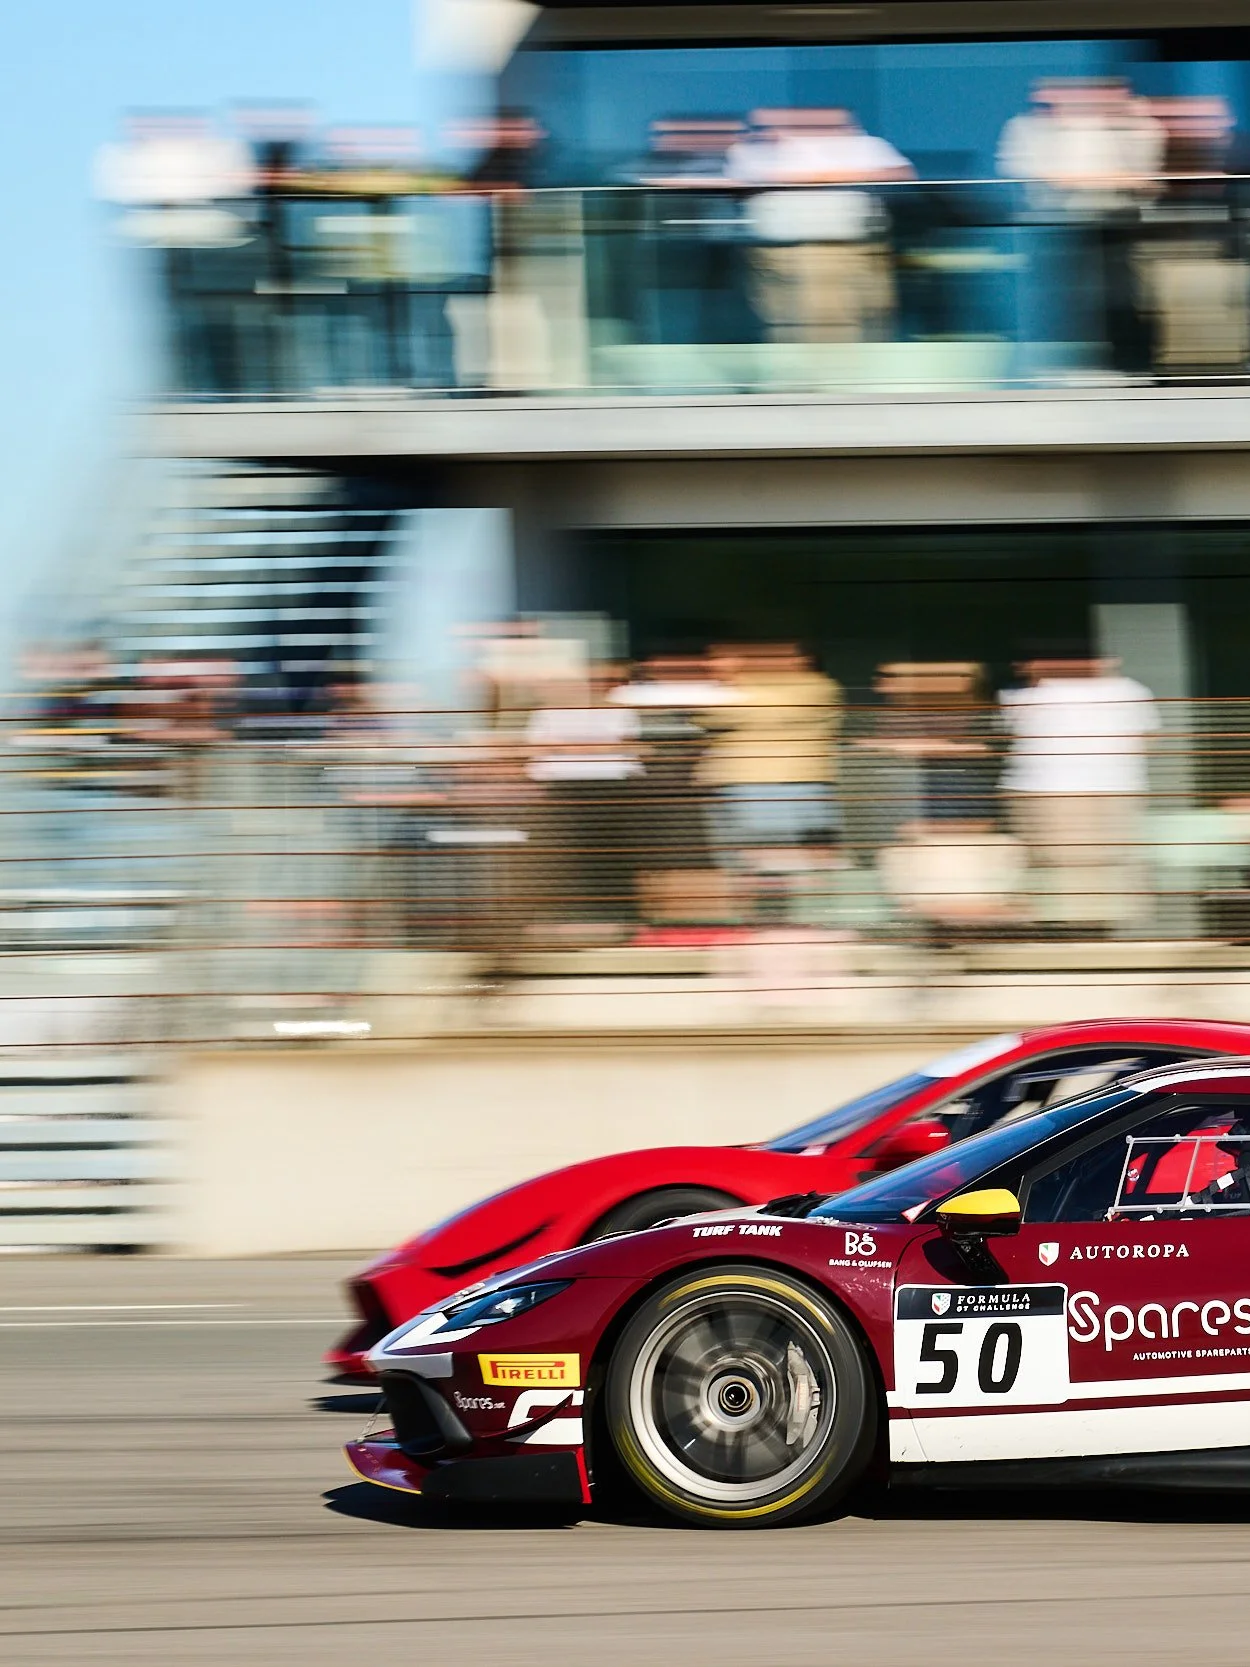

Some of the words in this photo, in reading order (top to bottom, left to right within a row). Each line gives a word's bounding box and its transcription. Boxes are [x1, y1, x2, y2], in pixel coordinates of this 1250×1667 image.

[692, 1225, 736, 1238] TURF
[738, 1224, 784, 1237] TANK
[1069, 1243, 1190, 1260] AUTOROPA
[828, 1259, 851, 1267] BANG
[851, 1260, 858, 1268] &
[858, 1260, 892, 1269] OLUFSEN
[957, 1293, 1031, 1305] FORMULA
[973, 1303, 1031, 1312] CHALLENGE
[916, 1322, 1022, 1394] 50
[1132, 1350, 1193, 1361] AUTOMOTIVE
[489, 1361, 566, 1379] PIRELLI
